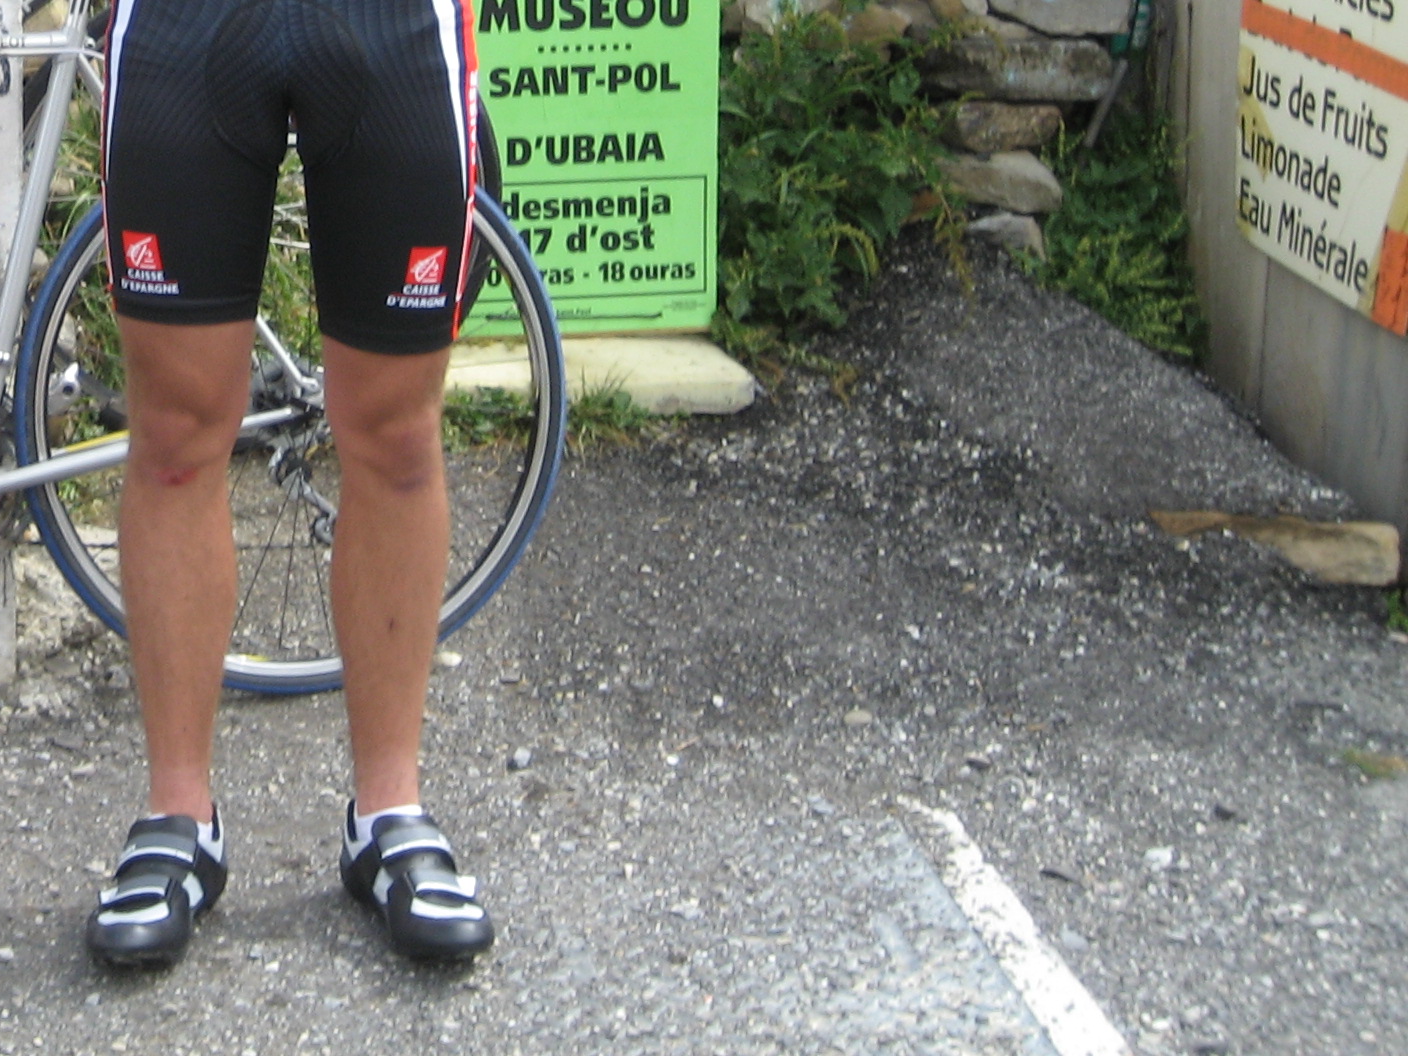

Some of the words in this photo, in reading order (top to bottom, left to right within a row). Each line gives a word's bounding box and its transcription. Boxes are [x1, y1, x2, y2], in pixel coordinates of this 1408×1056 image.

[489, 62, 681, 98] SANT-POL
[1242, 55, 1282, 111] Jus
[1288, 74, 1316, 127] de
[1321, 88, 1390, 161] Fruits
[506, 131, 665, 168] D'UBAIA
[1240, 114, 1343, 209] Limonade
[565, 223, 655, 253] d'ost
[1238, 177, 1272, 237] Eau
[1277, 199, 1369, 294] Minérale
[598, 261, 625, 283] 18
[629, 261, 696, 281] ouras
